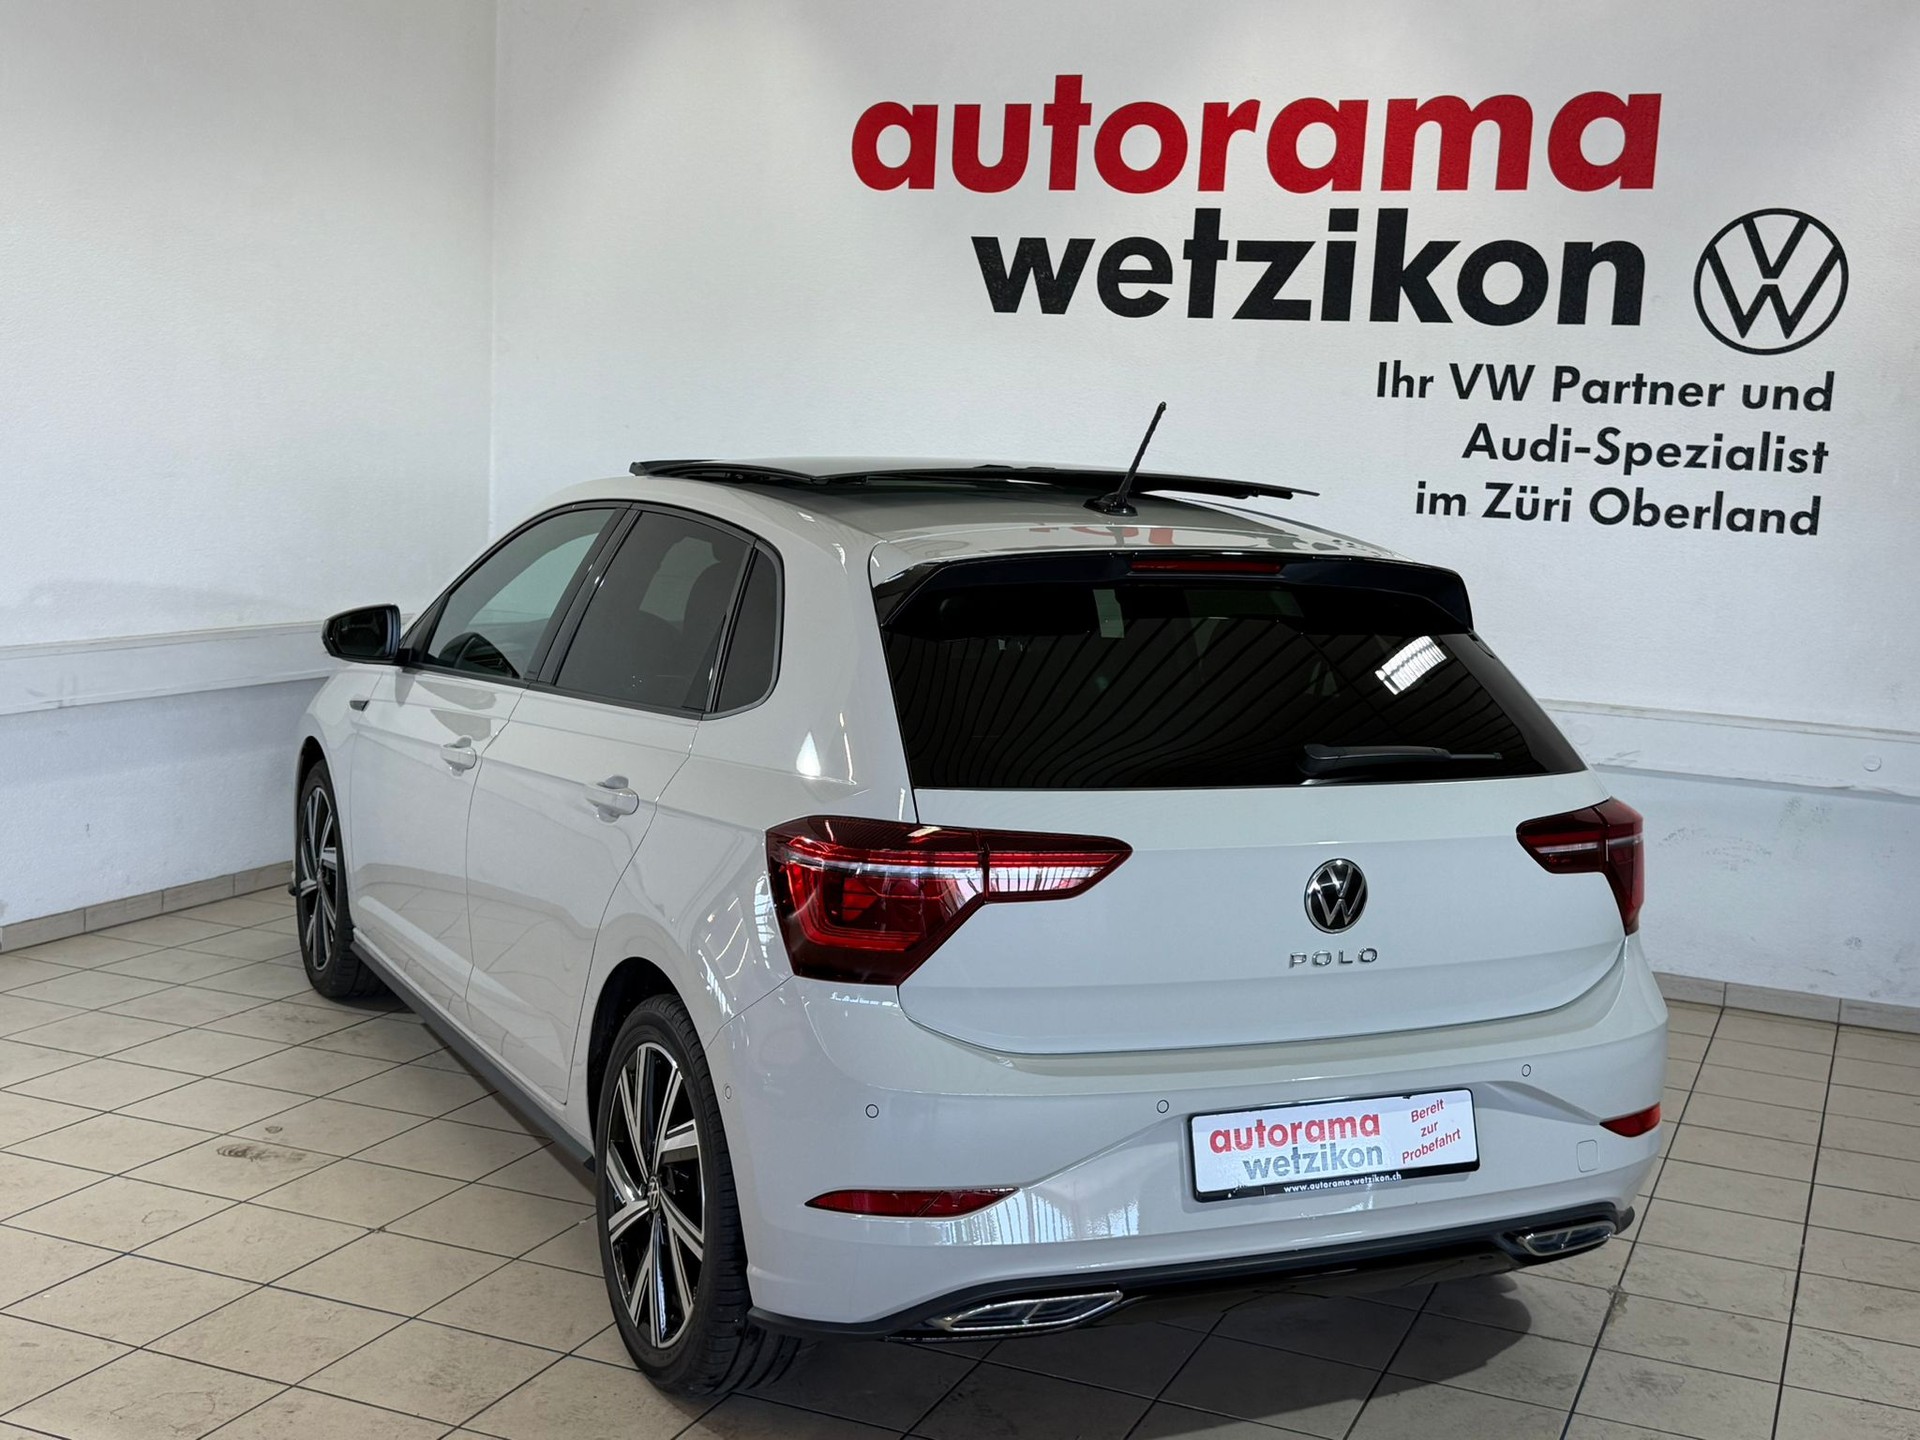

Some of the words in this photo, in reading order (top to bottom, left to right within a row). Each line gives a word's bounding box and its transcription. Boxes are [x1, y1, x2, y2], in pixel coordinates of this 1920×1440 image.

[852, 75, 1661, 194] autorama
[971, 207, 1646, 327] wetzikon
[1376, 359, 1434, 399] Ihr
[1448, 362, 1536, 402] VW
[1552, 365, 1726, 408] Partner
[1741, 370, 1835, 412] und
[1461, 422, 1830, 476] Audi-Spezialist
[1415, 480, 1467, 517] im
[1481, 481, 1573, 523] Züri
[1588, 486, 1822, 536] Oberland
[1288, 947, 1378, 969] POLO
[1410, 1098, 1445, 1123] Bereit
[1420, 1119, 1439, 1138] zur
[1209, 1112, 1380, 1154] autorama
[1401, 1127, 1462, 1165] Probefahrt
[1242, 1143, 1384, 1180] wetzikon
[1283, 1171, 1403, 1194] www.autorama-wetzikon.ch
